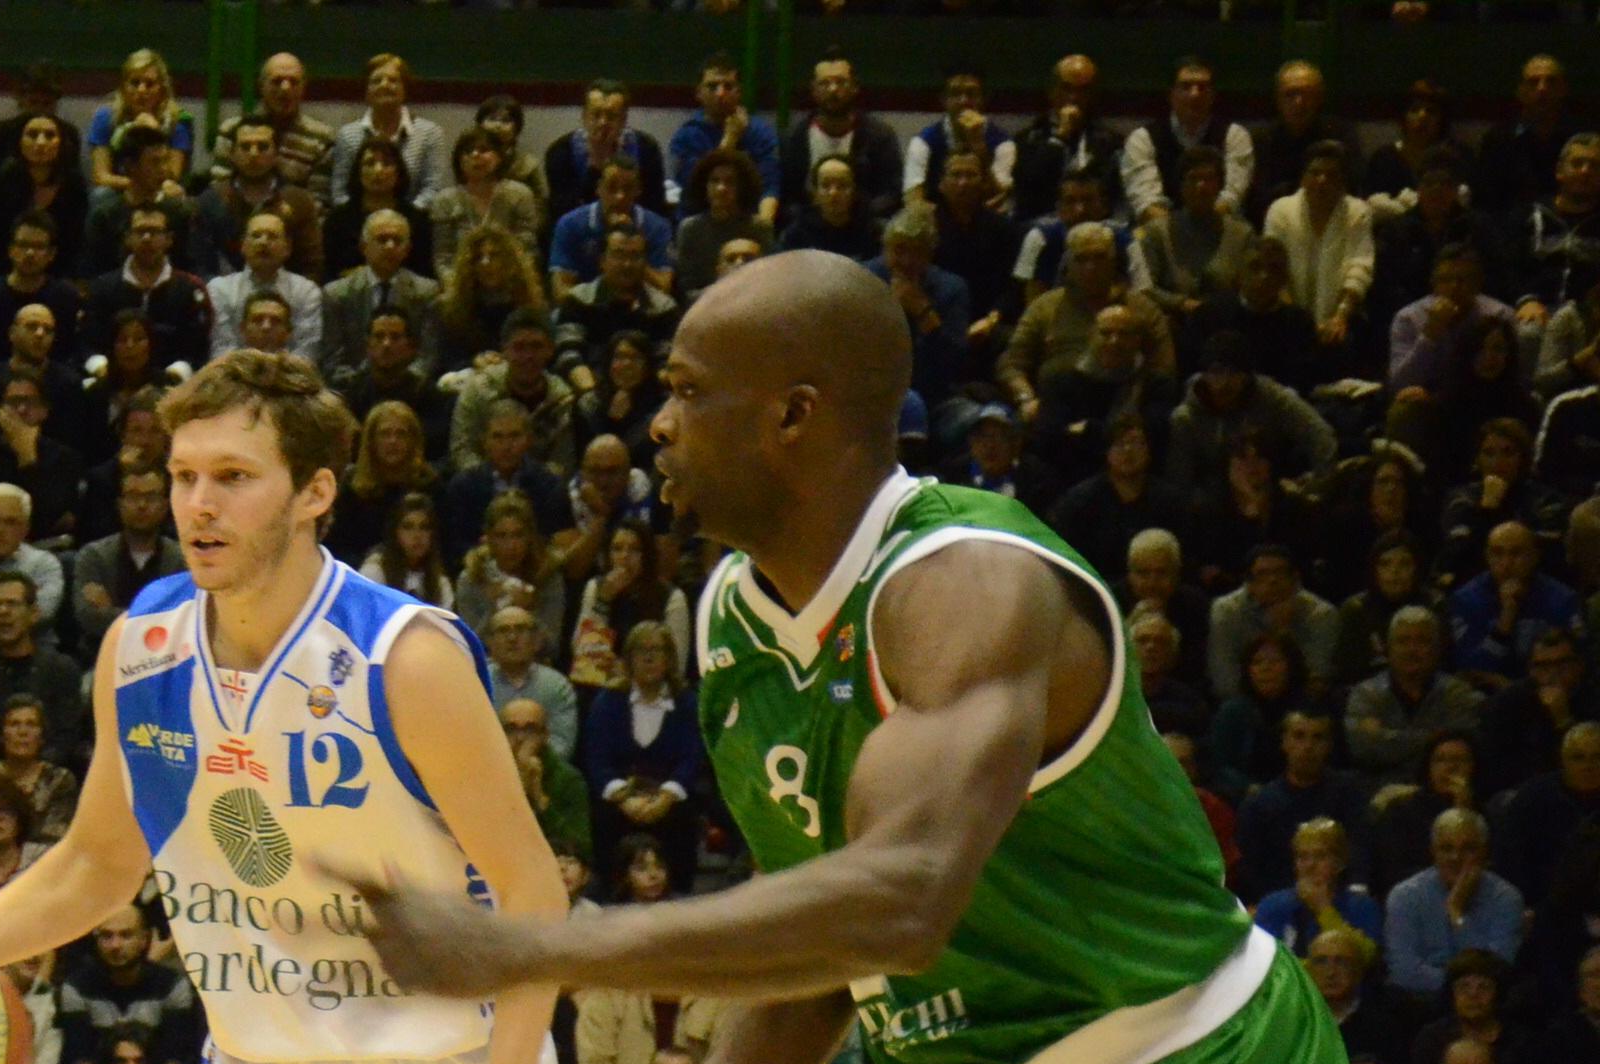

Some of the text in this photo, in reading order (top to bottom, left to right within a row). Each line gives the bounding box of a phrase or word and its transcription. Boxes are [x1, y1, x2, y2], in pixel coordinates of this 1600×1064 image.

[280, 730, 370, 810] 12
[764, 743, 822, 839] 8
[319, 892, 368, 937] di
